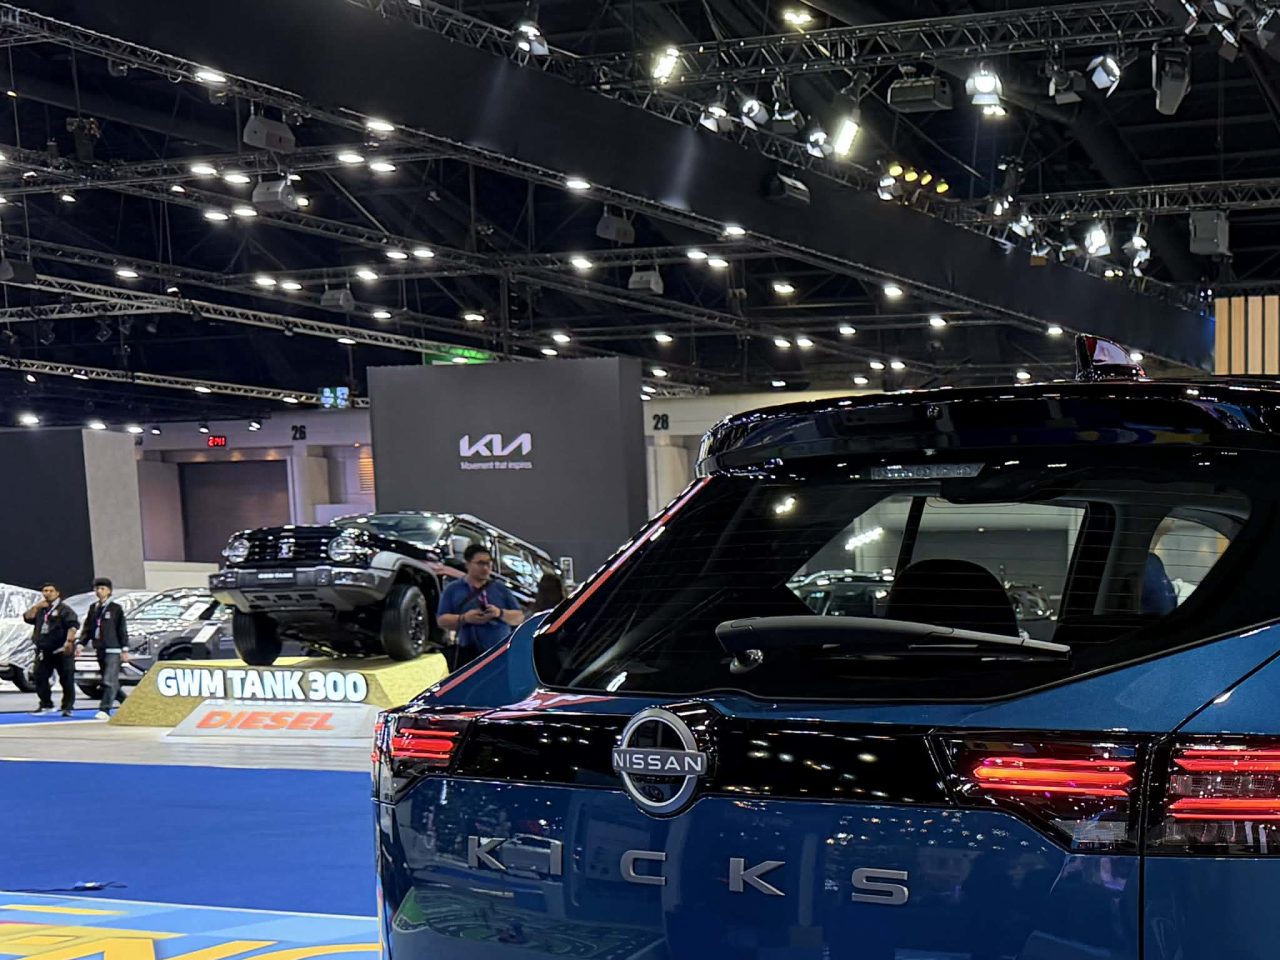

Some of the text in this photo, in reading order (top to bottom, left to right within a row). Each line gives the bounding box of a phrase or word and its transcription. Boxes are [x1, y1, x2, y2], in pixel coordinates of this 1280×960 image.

[652, 413, 669, 430] 28
[291, 425, 307, 440] 26
[460, 432, 531, 457] KIA
[157, 668, 368, 702] GWM TANK 300
[196, 710, 335, 731] DIESEL
[613, 752, 702, 771] NISSAN
[467, 835, 910, 905] KICKS
